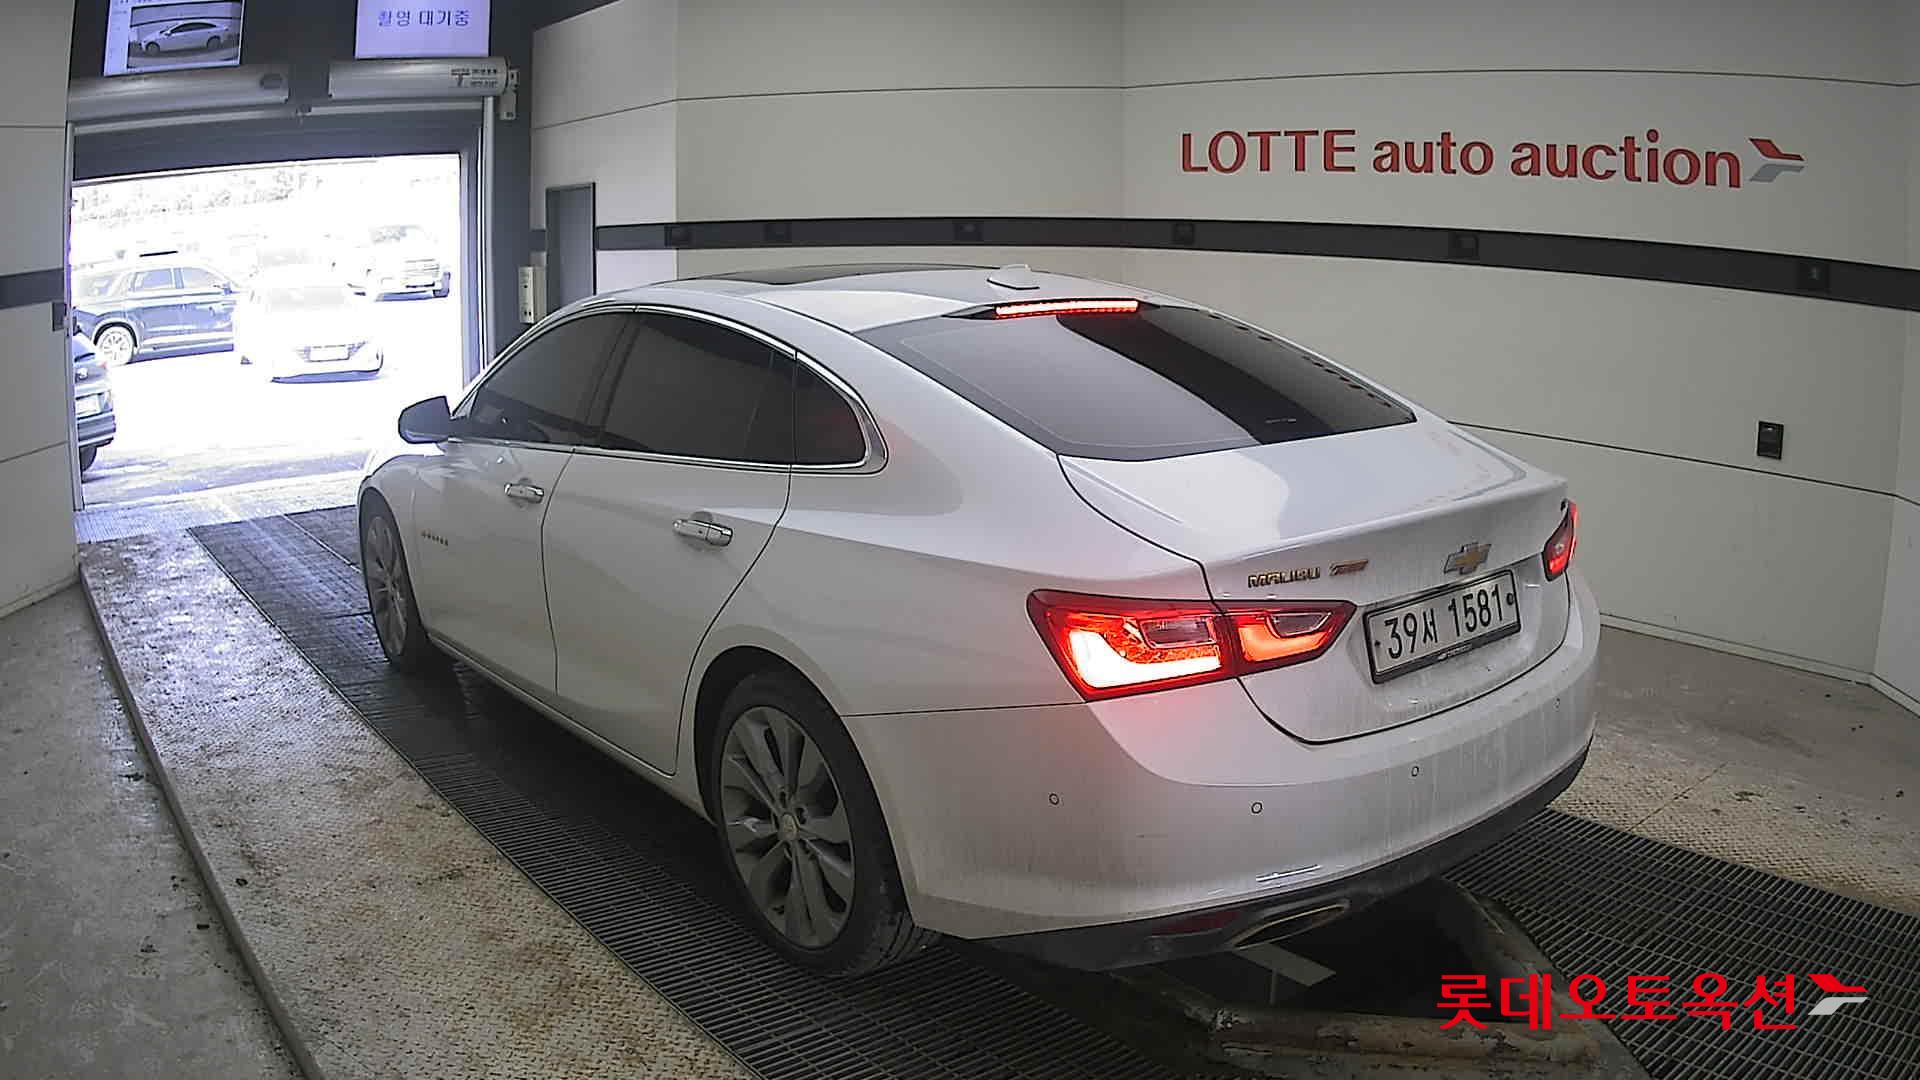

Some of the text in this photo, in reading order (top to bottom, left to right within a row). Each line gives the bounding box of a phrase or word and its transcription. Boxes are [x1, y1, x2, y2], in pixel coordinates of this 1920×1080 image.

[419, 10, 470, 27] 대기중
[1181, 129, 1741, 188] LOTTE auto auction
[1248, 567, 1320, 588] MALIBU
[1384, 583, 1504, 660] 39서 1581
